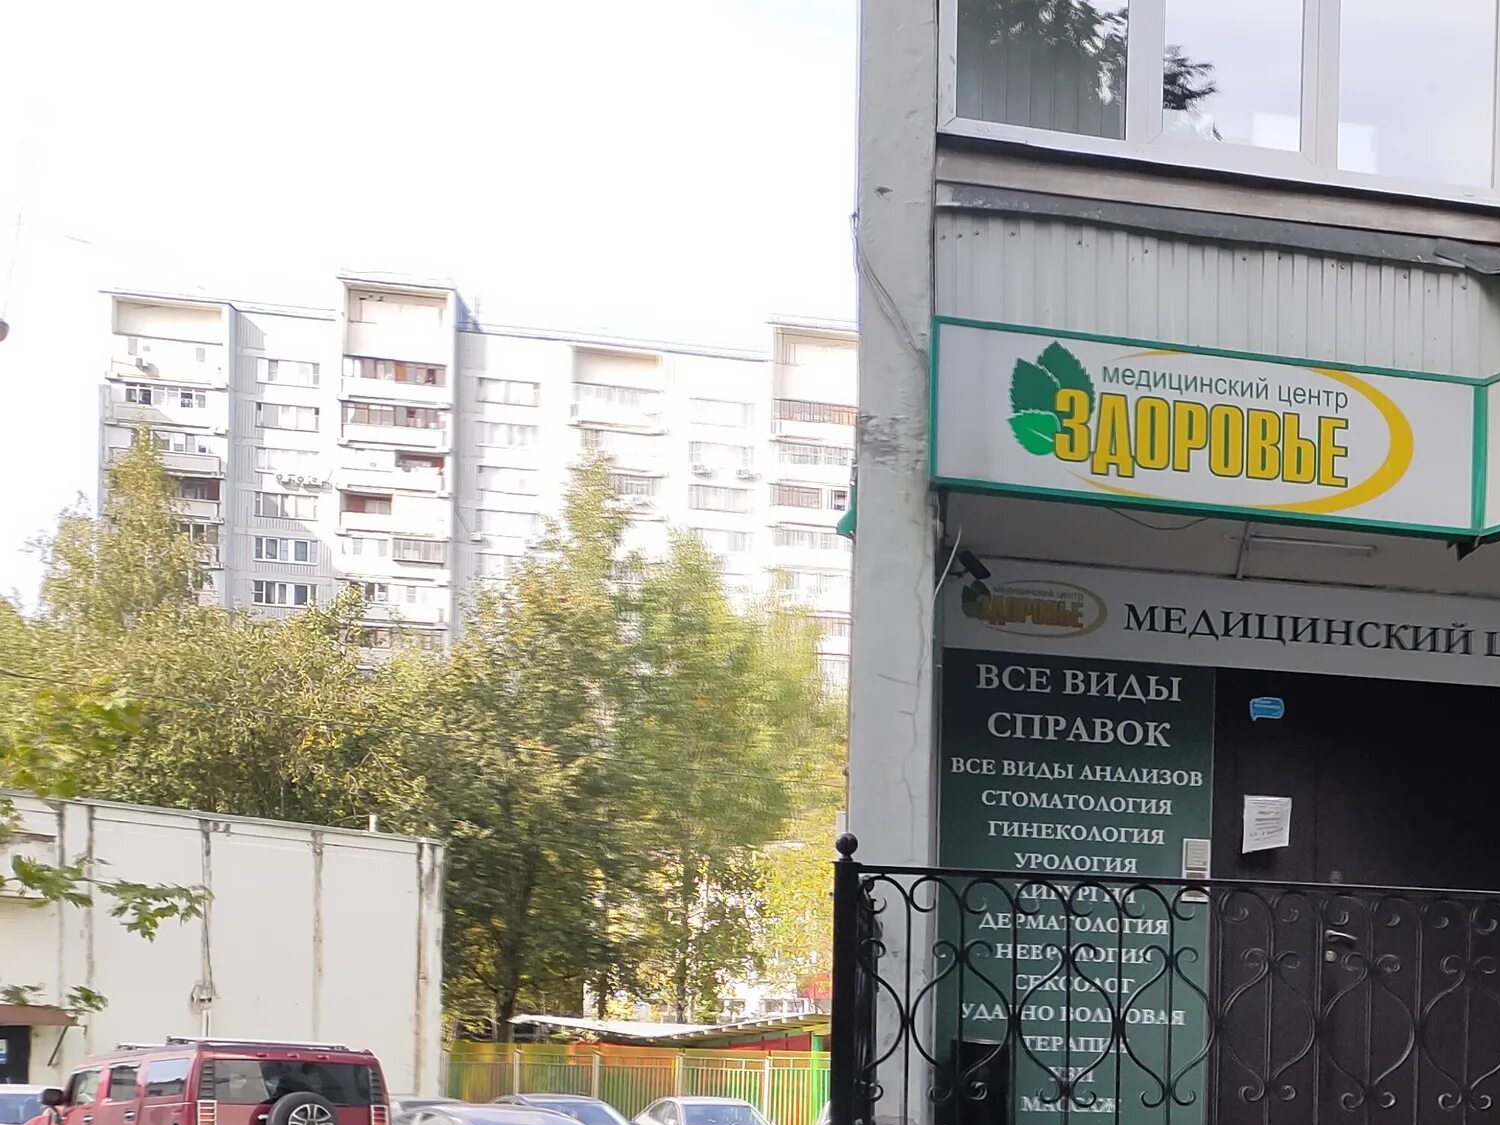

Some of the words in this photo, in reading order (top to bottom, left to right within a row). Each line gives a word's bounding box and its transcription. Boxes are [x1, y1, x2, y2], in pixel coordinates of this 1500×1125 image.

[1102, 365, 1270, 401] медицинский
[1278, 386, 1349, 411] центр
[1053, 387, 1350, 489] ЗДОРОВЬЕ
[1123, 603, 1473, 658] МЕДИЦИНСКИЙ
[976, 664, 1051, 693] ВСЕ
[1062, 670, 1183, 704] ВИДЫ
[987, 711, 1171, 748] СПРАВОК
[951, 757, 996, 776] ВСЕ
[1002, 760, 1074, 781] ВИДЫ
[1079, 765, 1203, 787] АНАЛИЗОВ
[981, 789, 1173, 816] СТОМАТОЛОГИЯ
[988, 820, 1165, 846] ГИНЕКОЛОГИЯ
[1014, 852, 1138, 875] УРОЛОГИЯ
[979, 912, 1169, 936] ДЕРМАТОЛОГИЯ
[995, 943, 1152, 964] НЕВРЛОГИЯ
[962, 1003, 1054, 1023] УДАНО
